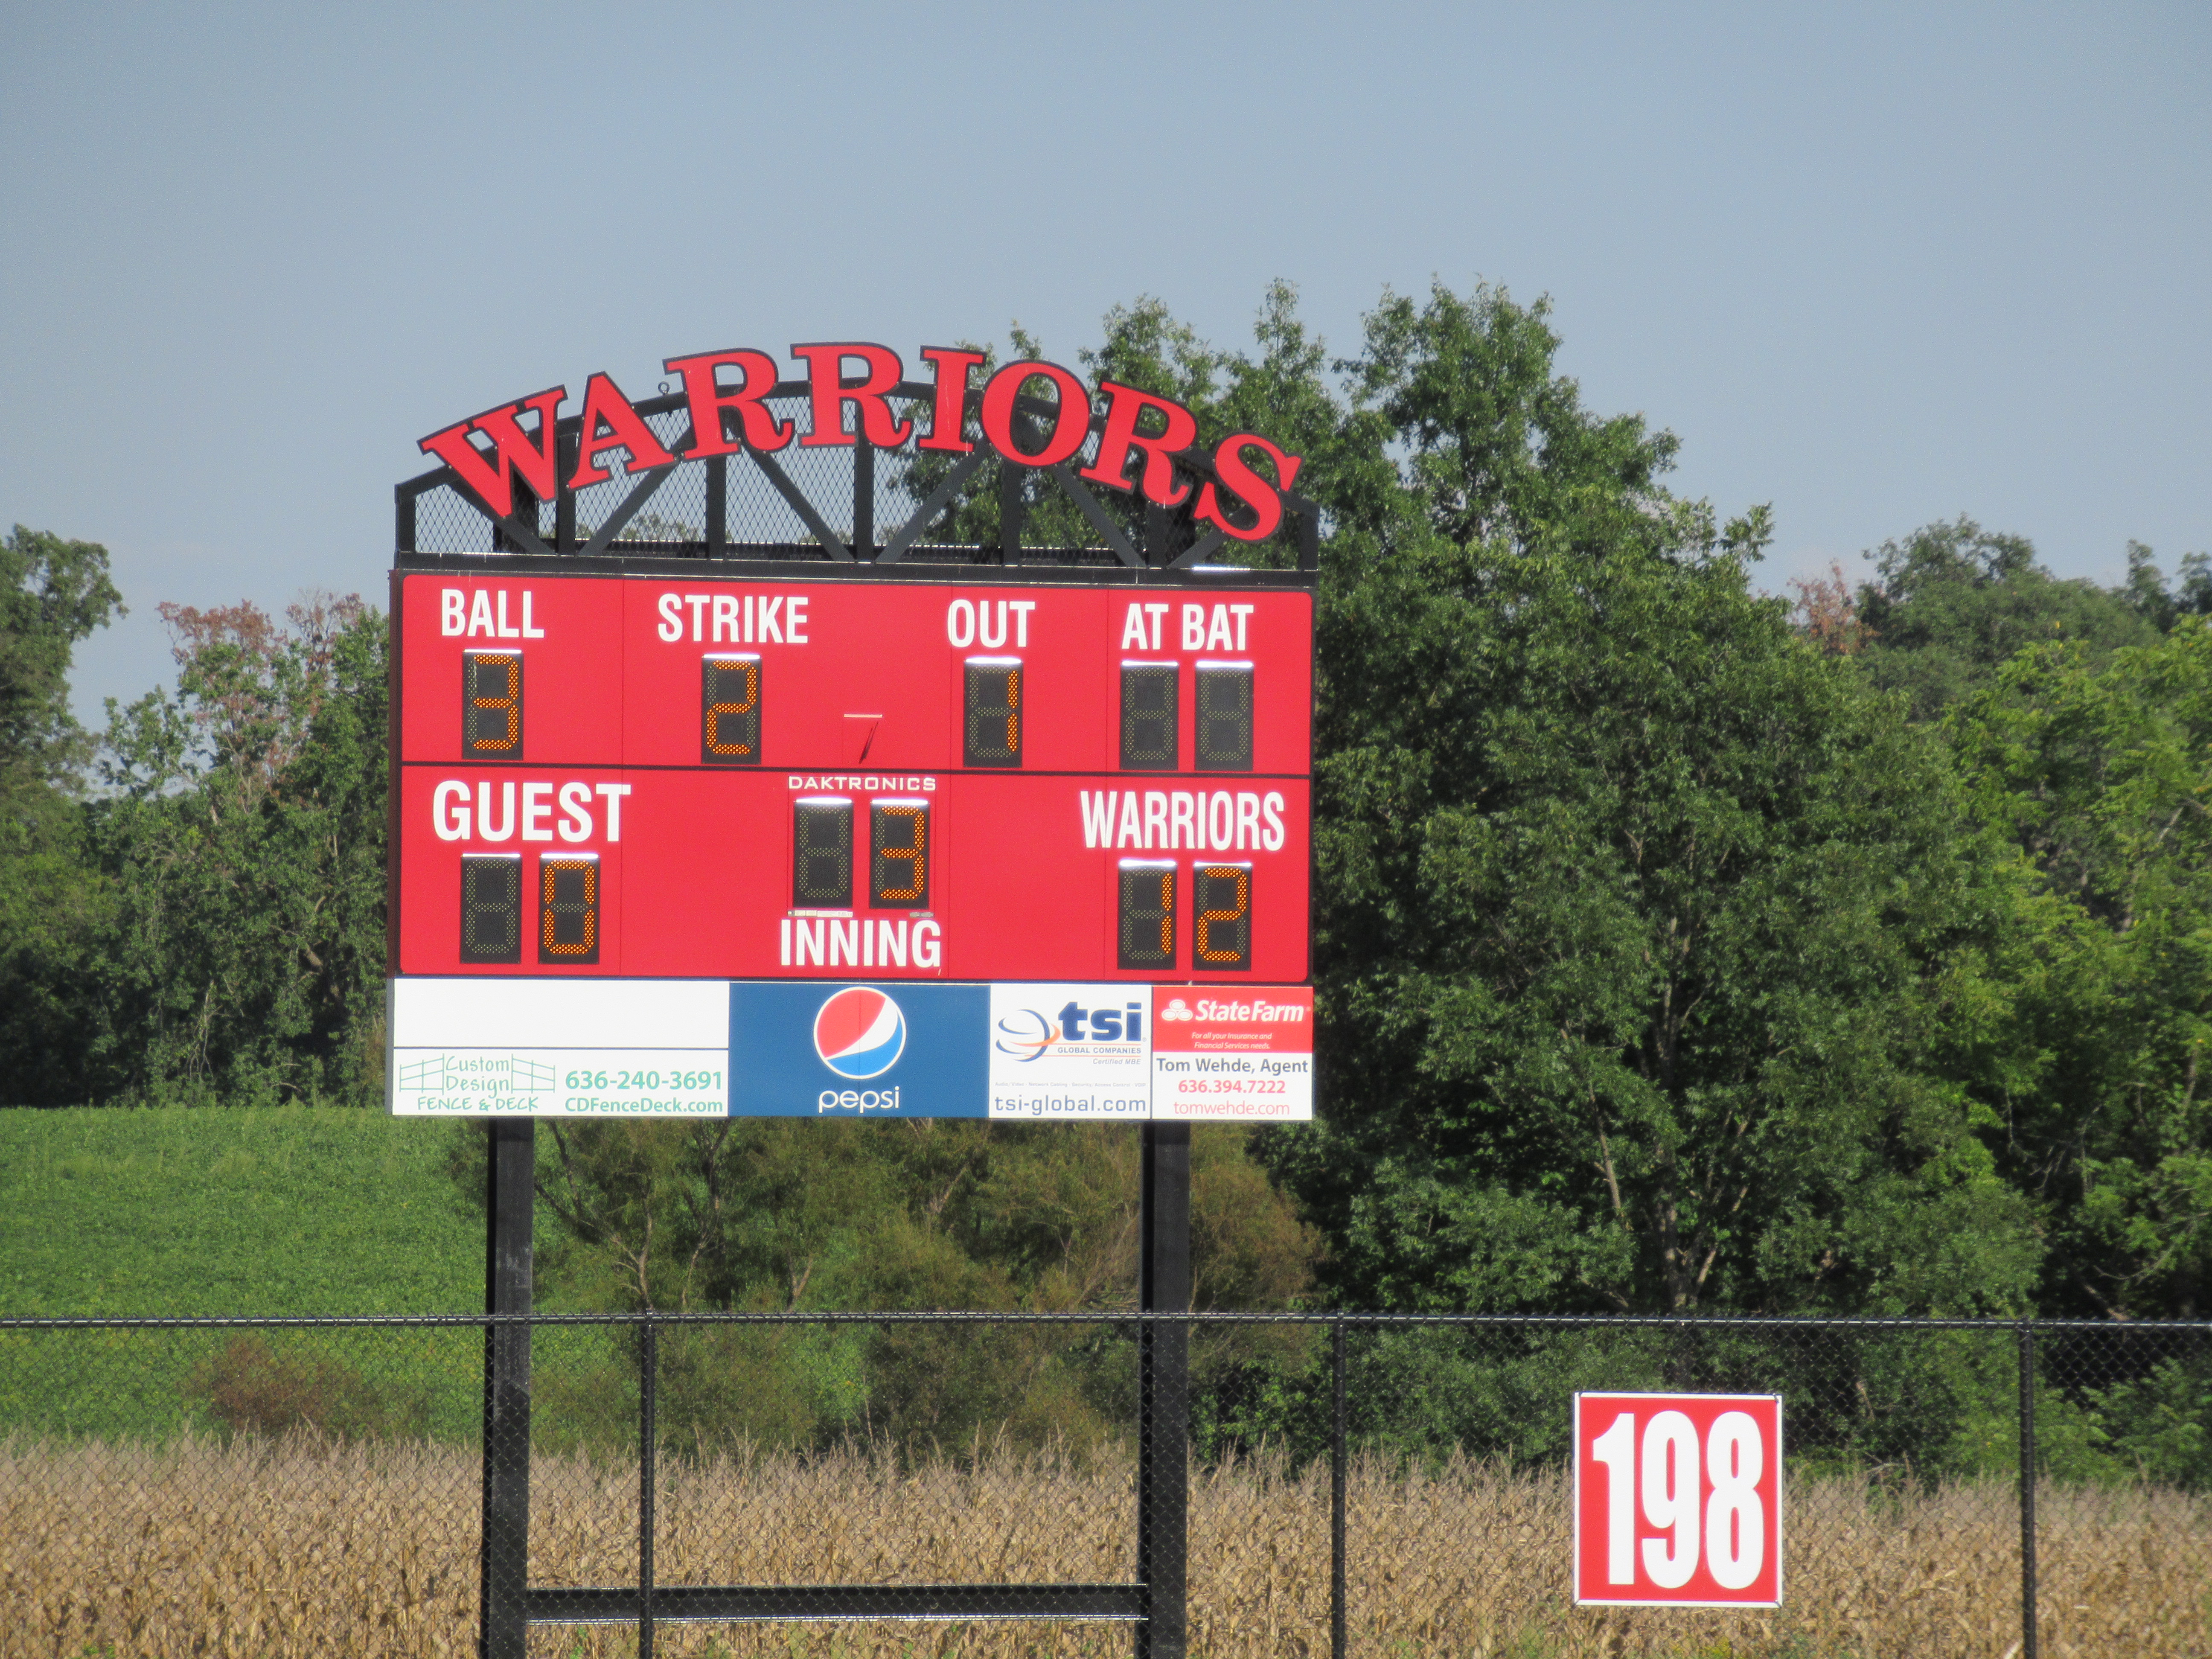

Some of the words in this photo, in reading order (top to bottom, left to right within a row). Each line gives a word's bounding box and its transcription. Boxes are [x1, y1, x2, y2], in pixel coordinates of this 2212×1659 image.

[416, 341, 1303, 542] WARRIORS
[442, 589, 544, 639] BALL
[658, 594, 809, 643] STRIKE
[947, 599, 1036, 648] OUT
[1121, 603, 1169, 650] AT
[1182, 604, 1254, 651] BAT
[473, 654, 519, 750] 3
[706, 659, 757, 755] 2
[789, 776, 937, 792] DAKTRONICS
[433, 780, 631, 843] GUEST
[1080, 790, 1284, 851] WARRIORS
[879, 805, 925, 900] 3
[543, 858, 596, 955] 0
[780, 920, 941, 968] INNING
[1058, 1001, 1142, 1042] tsi
[445, 1055, 509, 1072] Custom
[446, 1075, 509, 1099] Design
[565, 1070, 722, 1090] 636-240-3691
[1156, 1058, 1190, 1071] Tom
[1196, 1058, 1255, 1074] Wehde,
[1260, 1059, 1308, 1076] Agent
[1178, 1080, 1286, 1094] 636.394.7222
[417, 1096, 472, 1110] FENCE
[478, 1099, 491, 1112] &
[495, 1096, 539, 1112] DECK
[565, 1097, 723, 1112] CDFenceDeck.com
[818, 1086, 900, 1114] pepsi
[995, 1095, 1146, 1115] tsi-global.com
[1174, 1100, 1290, 1115] tomwehde.com
[1592, 1410, 1764, 1590] 198
